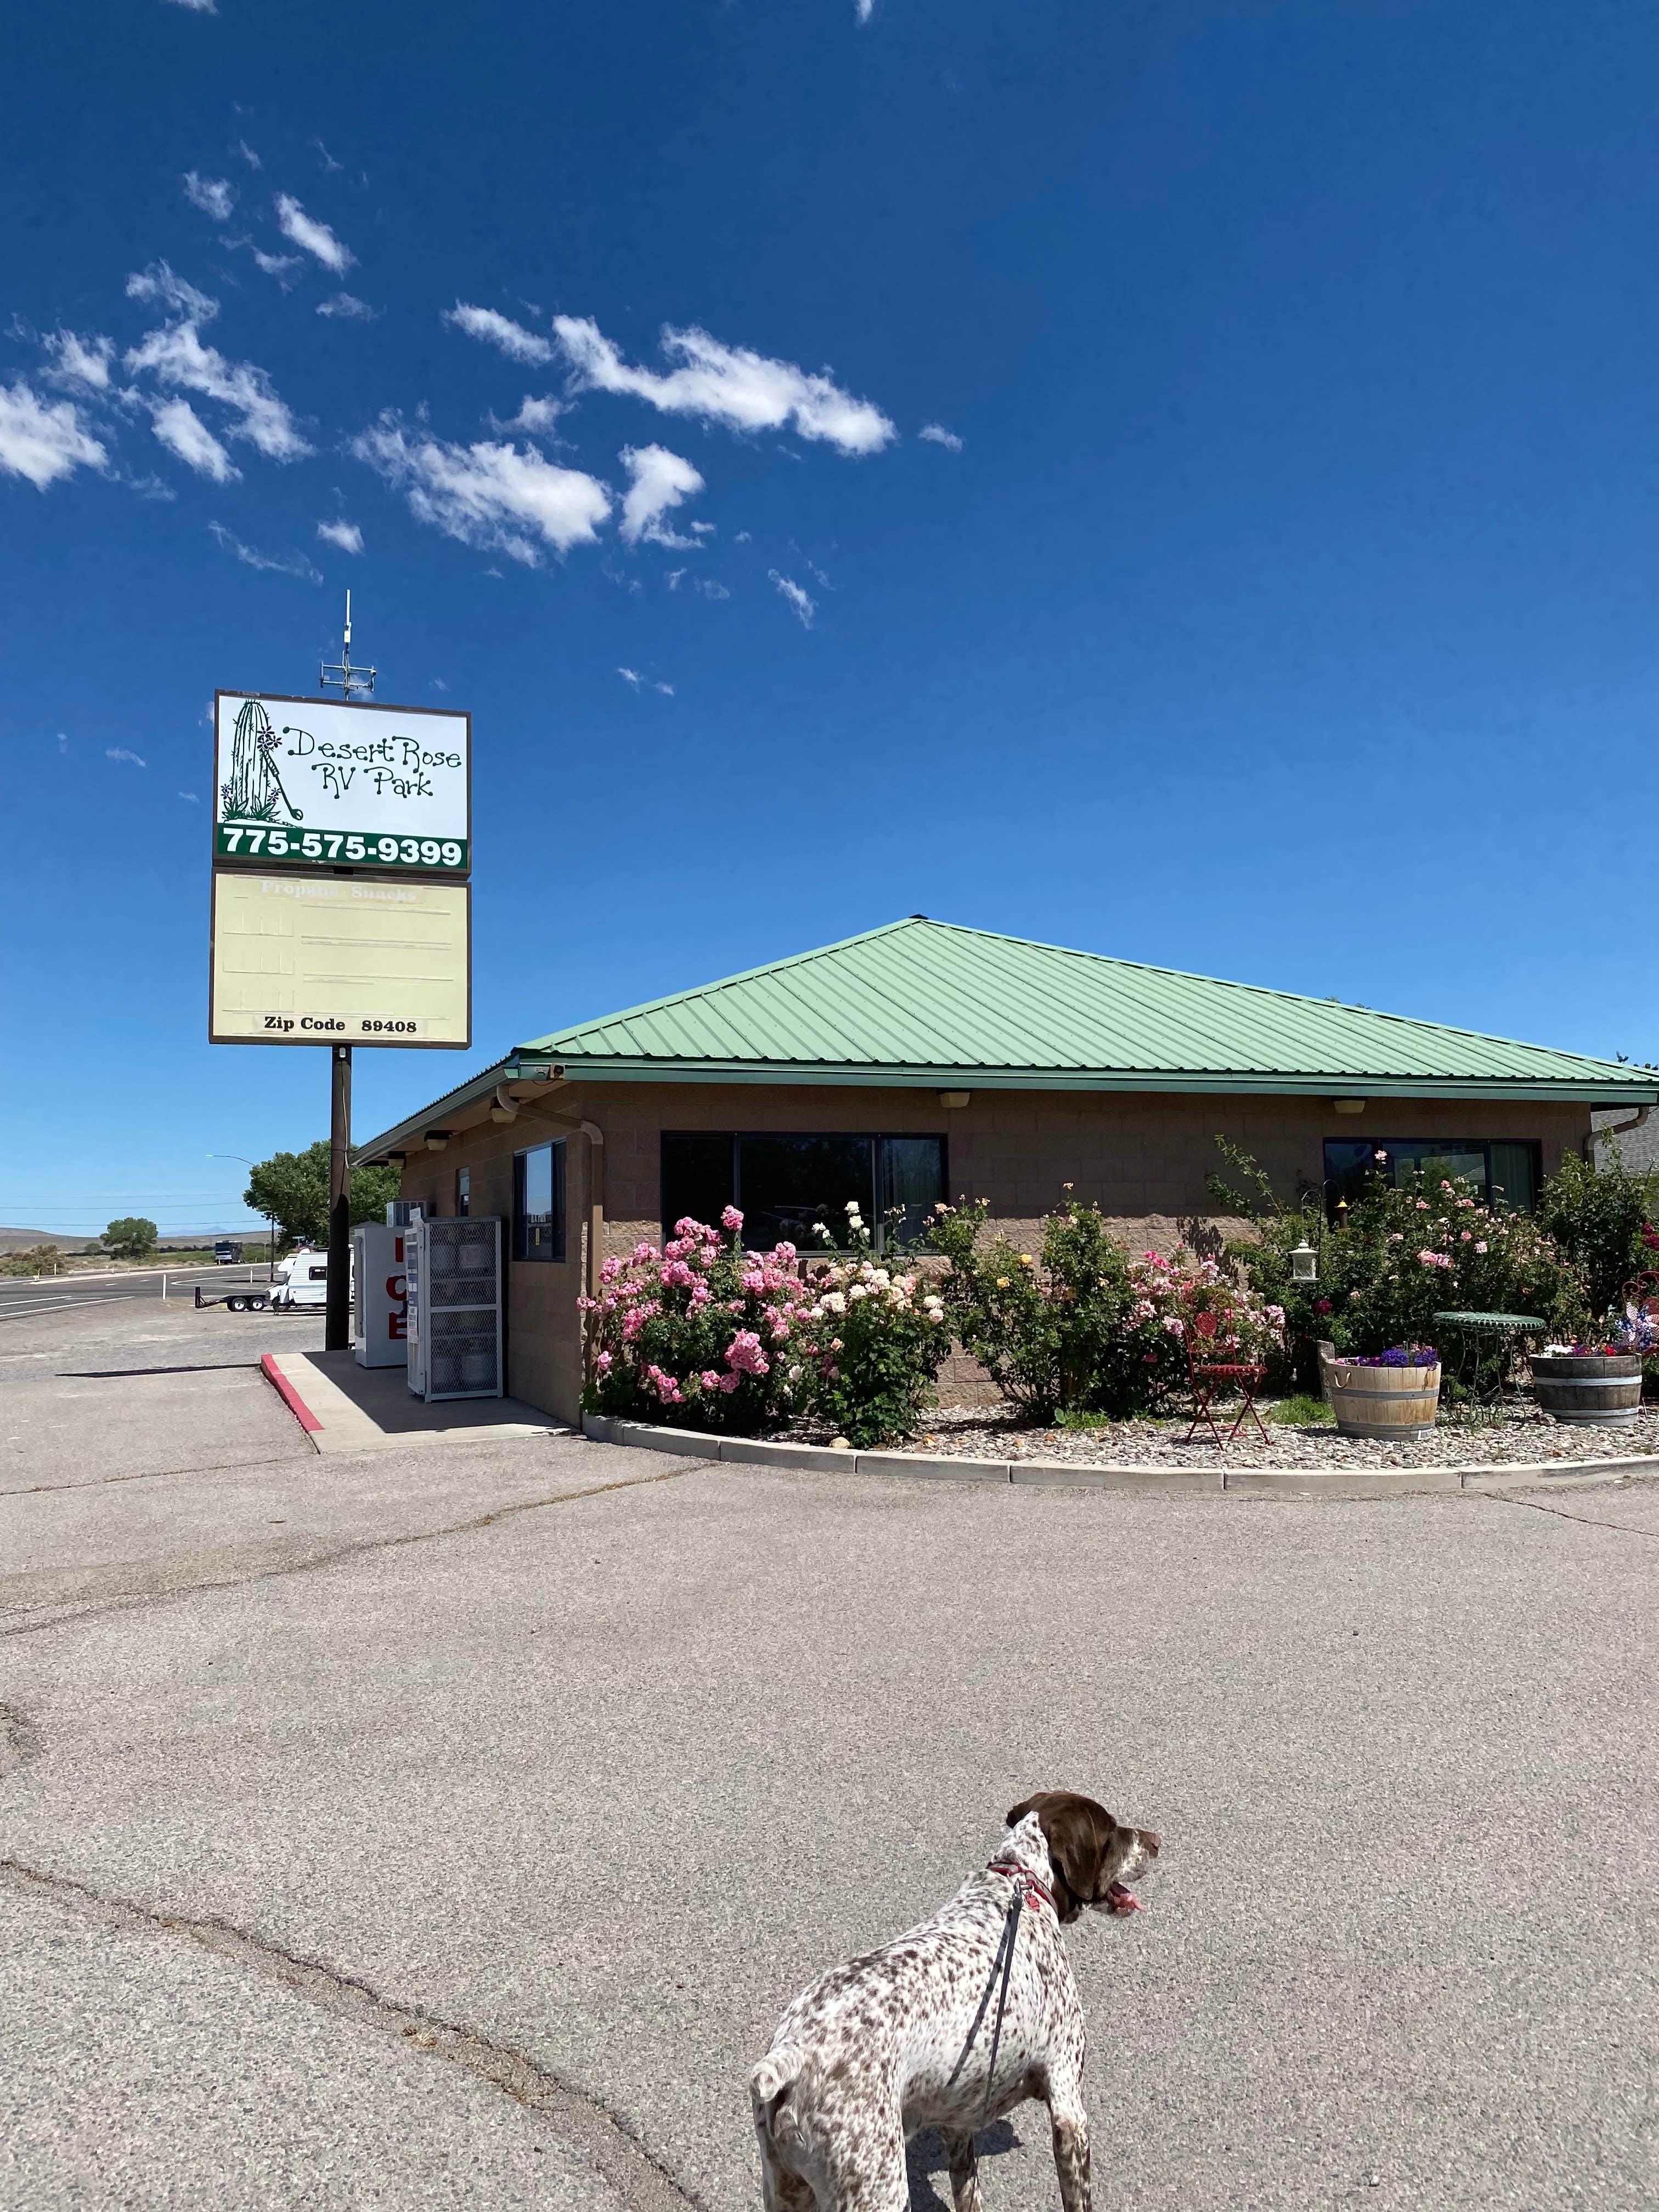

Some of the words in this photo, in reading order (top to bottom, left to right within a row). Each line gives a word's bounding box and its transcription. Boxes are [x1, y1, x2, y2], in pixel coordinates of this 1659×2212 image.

[283, 726, 395, 763] Desert
[392, 735, 462, 774] Rose
[312, 763, 356, 799] RV
[364, 766, 433, 798] Park
[223, 827, 462, 866] 775-575-9399
[261, 879, 339, 899] Propane
[351, 885, 417, 901] Snacks
[264, 1016, 295, 1032] Zip
[301, 1017, 346, 1031] Code
[361, 1020, 417, 1033] 89408
